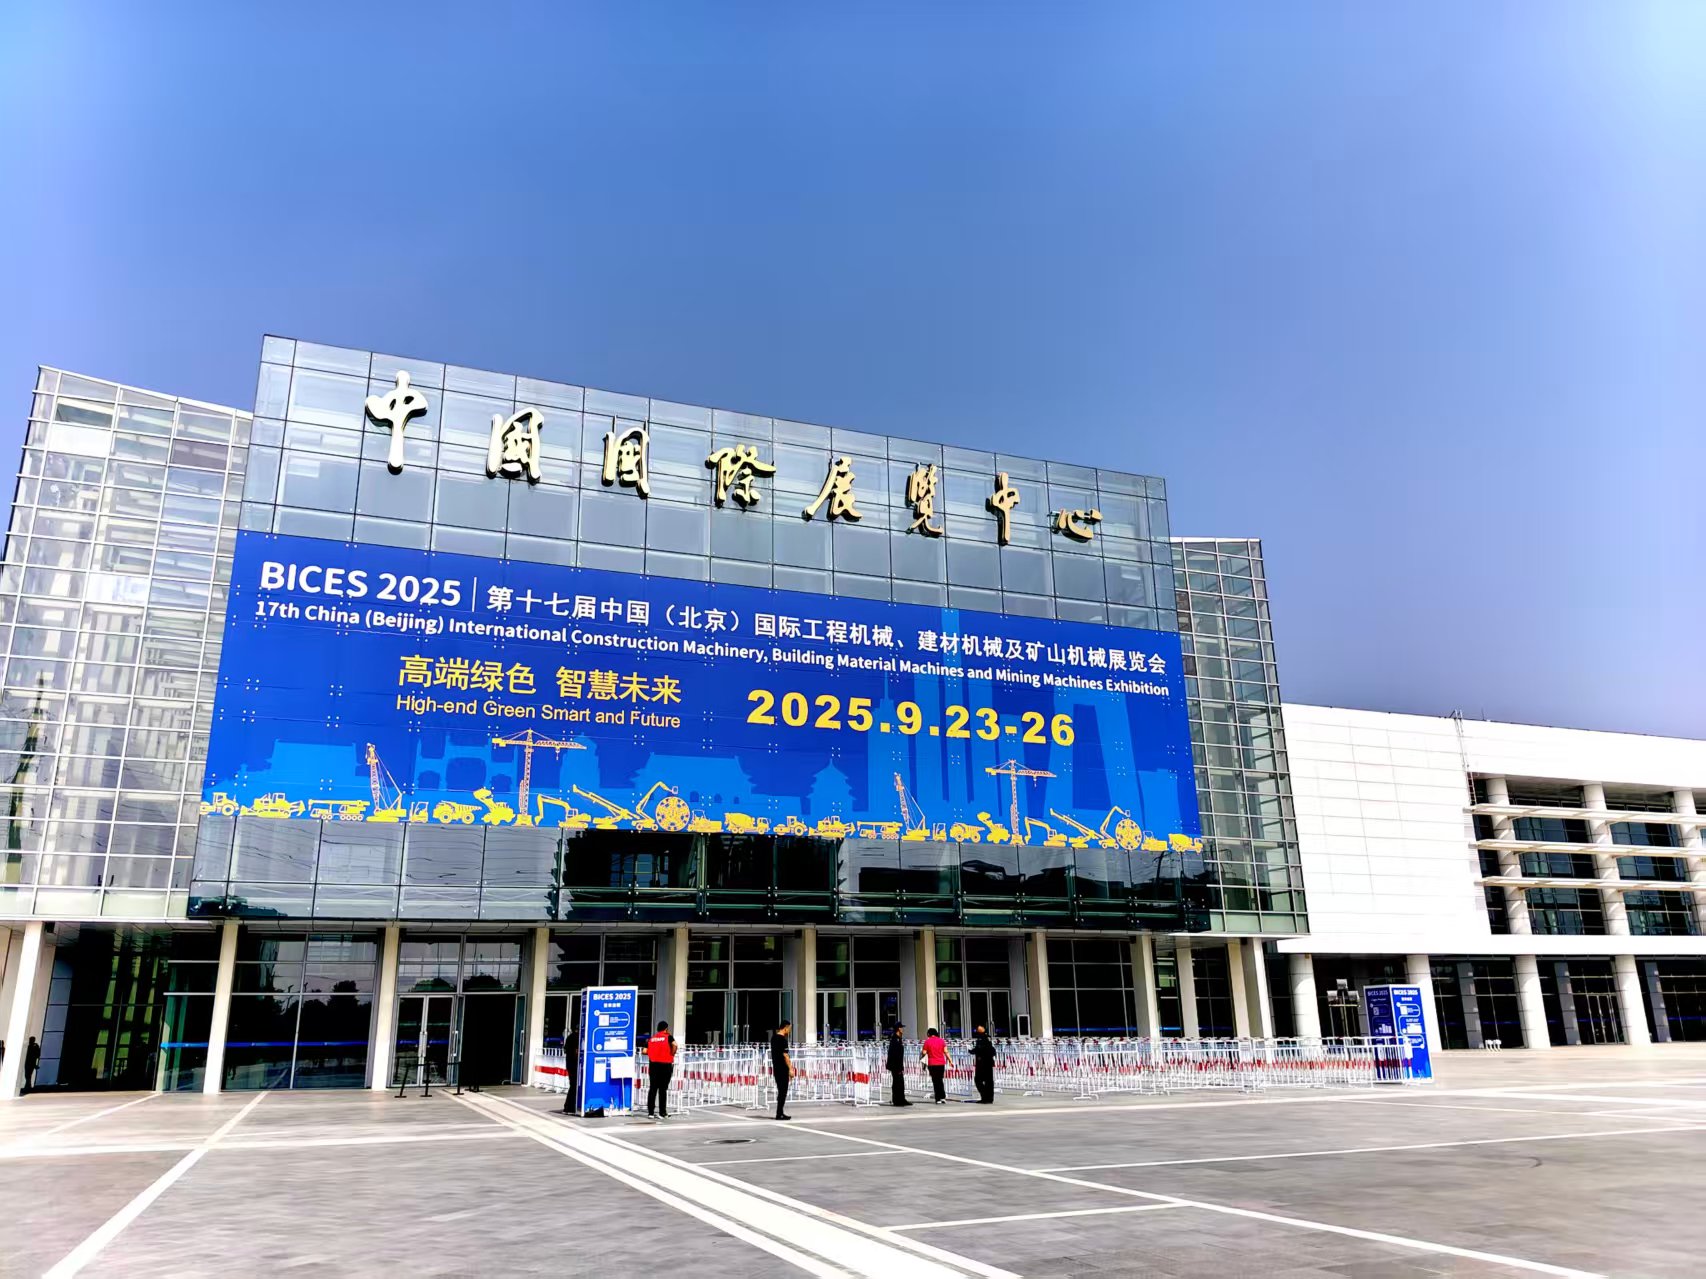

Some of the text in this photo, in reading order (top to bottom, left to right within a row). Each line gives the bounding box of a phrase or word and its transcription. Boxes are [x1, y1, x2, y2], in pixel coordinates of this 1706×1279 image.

[260, 561, 461, 606] BICES 2025
[255, 600, 1170, 697] 17th China (Beijing) International Construction Machinery, Building Material Machines and Mining Machines Exhibition
[486, 585, 1166, 675] 第十七届中国（北京）国际工程机械、建材机械及矿山机械展览会
[399, 654, 682, 705] 高端绿色 智慧未来
[396, 695, 681, 729] High-end Green Smart and Future
[746, 689, 1076, 748] 2025.9.23-26
